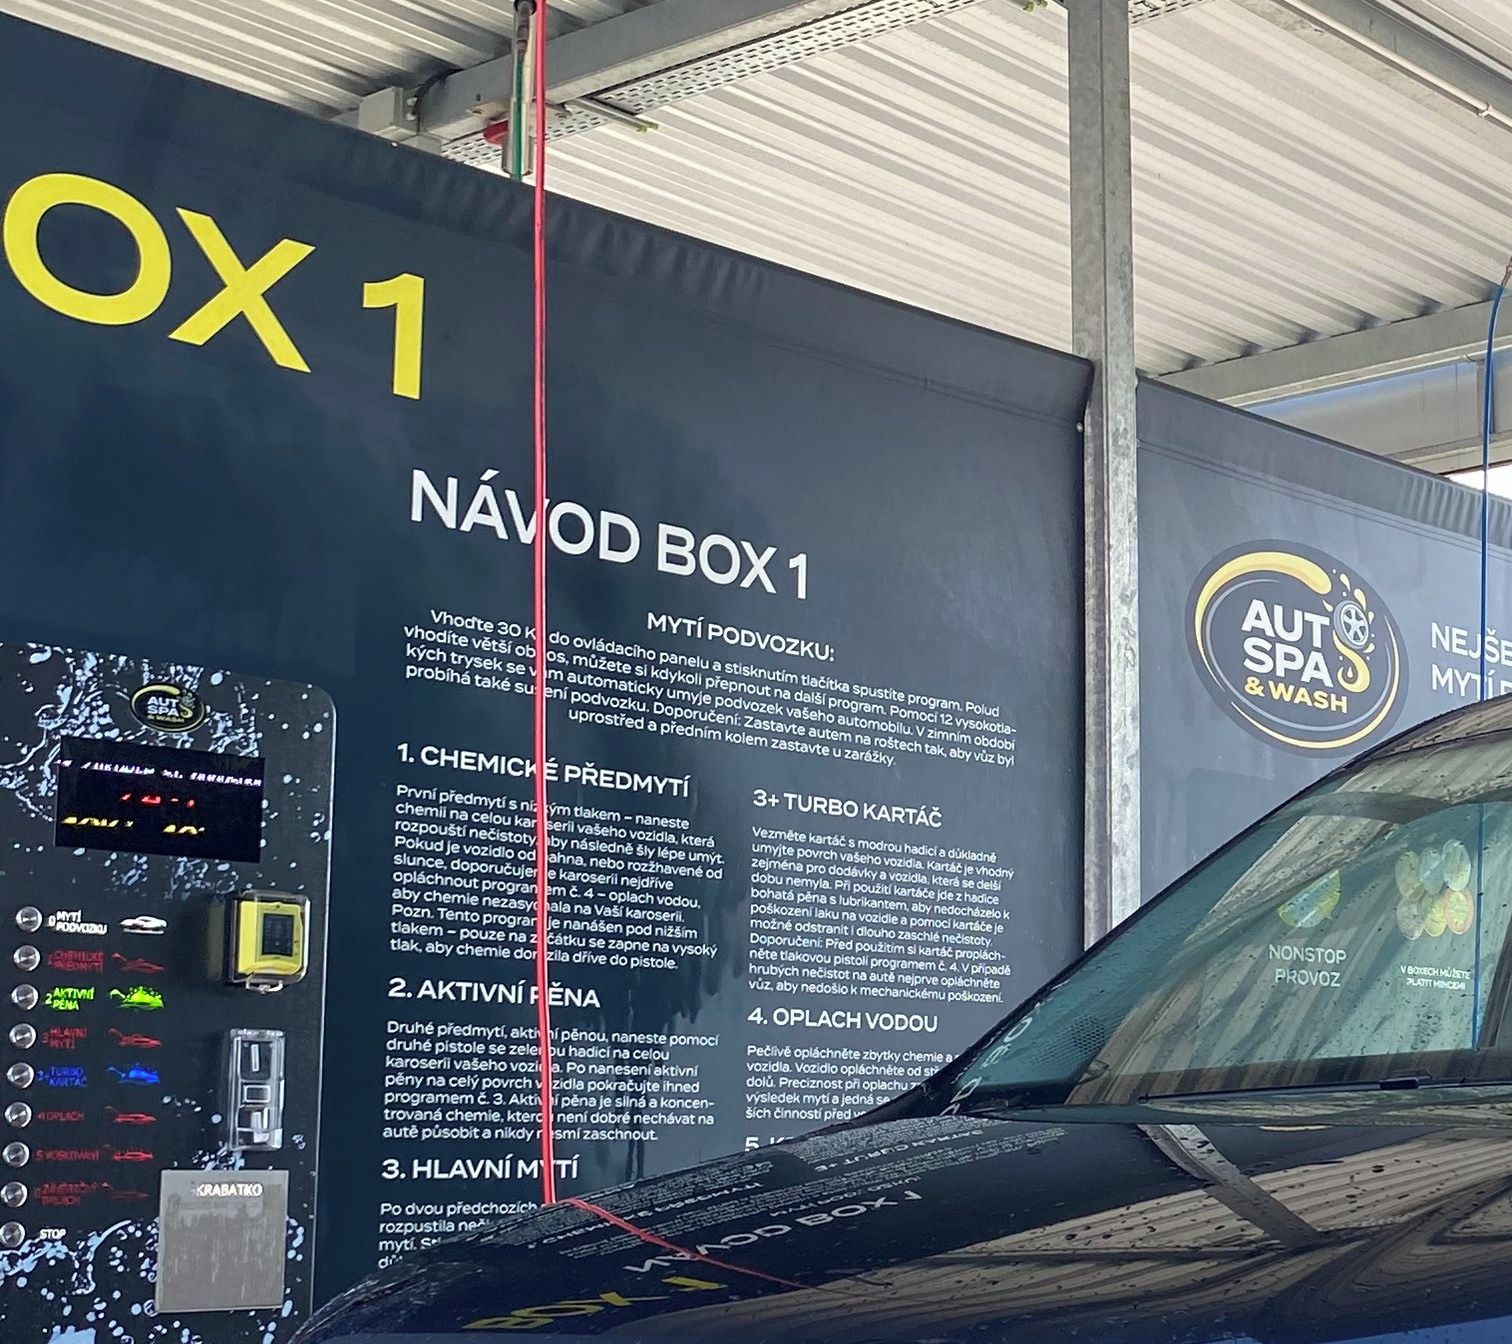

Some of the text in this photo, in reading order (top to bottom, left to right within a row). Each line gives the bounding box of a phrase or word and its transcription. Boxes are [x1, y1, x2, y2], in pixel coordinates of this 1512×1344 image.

[362, 273, 425, 400] 1
[410, 468, 808, 600] NÁVOD BOX 1
[646, 612, 834, 661] MYTÍ PODVOZKU:
[430, 609, 494, 632] Vhoďte
[496, 621, 521, 637] 30
[548, 631, 570, 646] do
[572, 637, 656, 660] ovládacího
[658, 651, 709, 669] panelu
[711, 660, 721, 671] a
[724, 662, 798, 683] stisknutím
[800, 674, 850, 693] tlačítka
[852, 684, 905, 702] spustíte
[907, 693, 962, 711] program.
[1243, 635, 1334, 689] SPA
[403, 624, 468, 647] vhodíte
[470, 636, 512, 654] větší
[572, 653, 632, 674] můžete
[634, 663, 647, 676] si
[704, 675, 771, 697] přepnout
[773, 687, 791, 700] na
[793, 689, 826, 705] další
[827, 696, 887, 715] program.
[889, 704, 938, 723] Pomocí
[938, 712, 953, 725] 12
[954, 717, 1016, 734] vysokotla-
[405, 642, 446, 662] kých
[449, 651, 503, 671] trysek
[505, 661, 526, 675] se
[566, 672, 664, 699] automaticky
[666, 688, 712, 706] umyje
[714, 695, 783, 715] podvozek
[785, 706, 835, 723] vašeho
[836, 714, 913, 735] automobilu.
[914, 724, 925, 736] V
[926, 727, 972, 744] zimním
[1244, 676, 1348, 714] & WASH
[147, 706, 180, 718] SPA
[568, 709, 896, 767] uprostřed a předním kolem zastavte u zarážky.
[396, 742, 414, 763] 1.
[564, 761, 690, 796] PŘEDMYTÍ
[752, 788, 942, 827] 3+ TURBO KARTÁČ
[55, 922, 108, 935] PODVOZKU
[56, 910, 82, 923] MYTÍ
[1269, 943, 1347, 965] NONSTOP
[387, 977, 412, 998] 2.
[416, 979, 523, 1003] AKTIVNÍ
[1274, 968, 1342, 988] PROVOZ
[45, 986, 95, 1005] 2 AKTIVNÍ
[746, 1006, 938, 1032] 4. OPLACH VODOU
[386, 1020, 434, 1035] Druhé
[436, 1022, 508, 1040] předmytí,
[560, 1027, 608, 1043] pěnou,
[610, 1032, 667, 1044] naneste
[668, 1034, 719, 1047] pomocí
[384, 1055, 698, 1076] karoserii vašeho Po nanesení aktivní
[383, 1091, 474, 1106] programem
[476, 1090, 490, 1105] č.
[492, 1092, 506, 1105] 3.
[560, 1093, 597, 1108] pěna
[597, 1094, 612, 1110] je
[614, 1094, 646, 1108] silná
[648, 1097, 658, 1108] a
[659, 1096, 715, 1109] koncen-
[380, 1158, 406, 1179] 3.
[412, 1154, 510, 1179] HLAVNÍ
[40, 1228, 67, 1240] STOP
